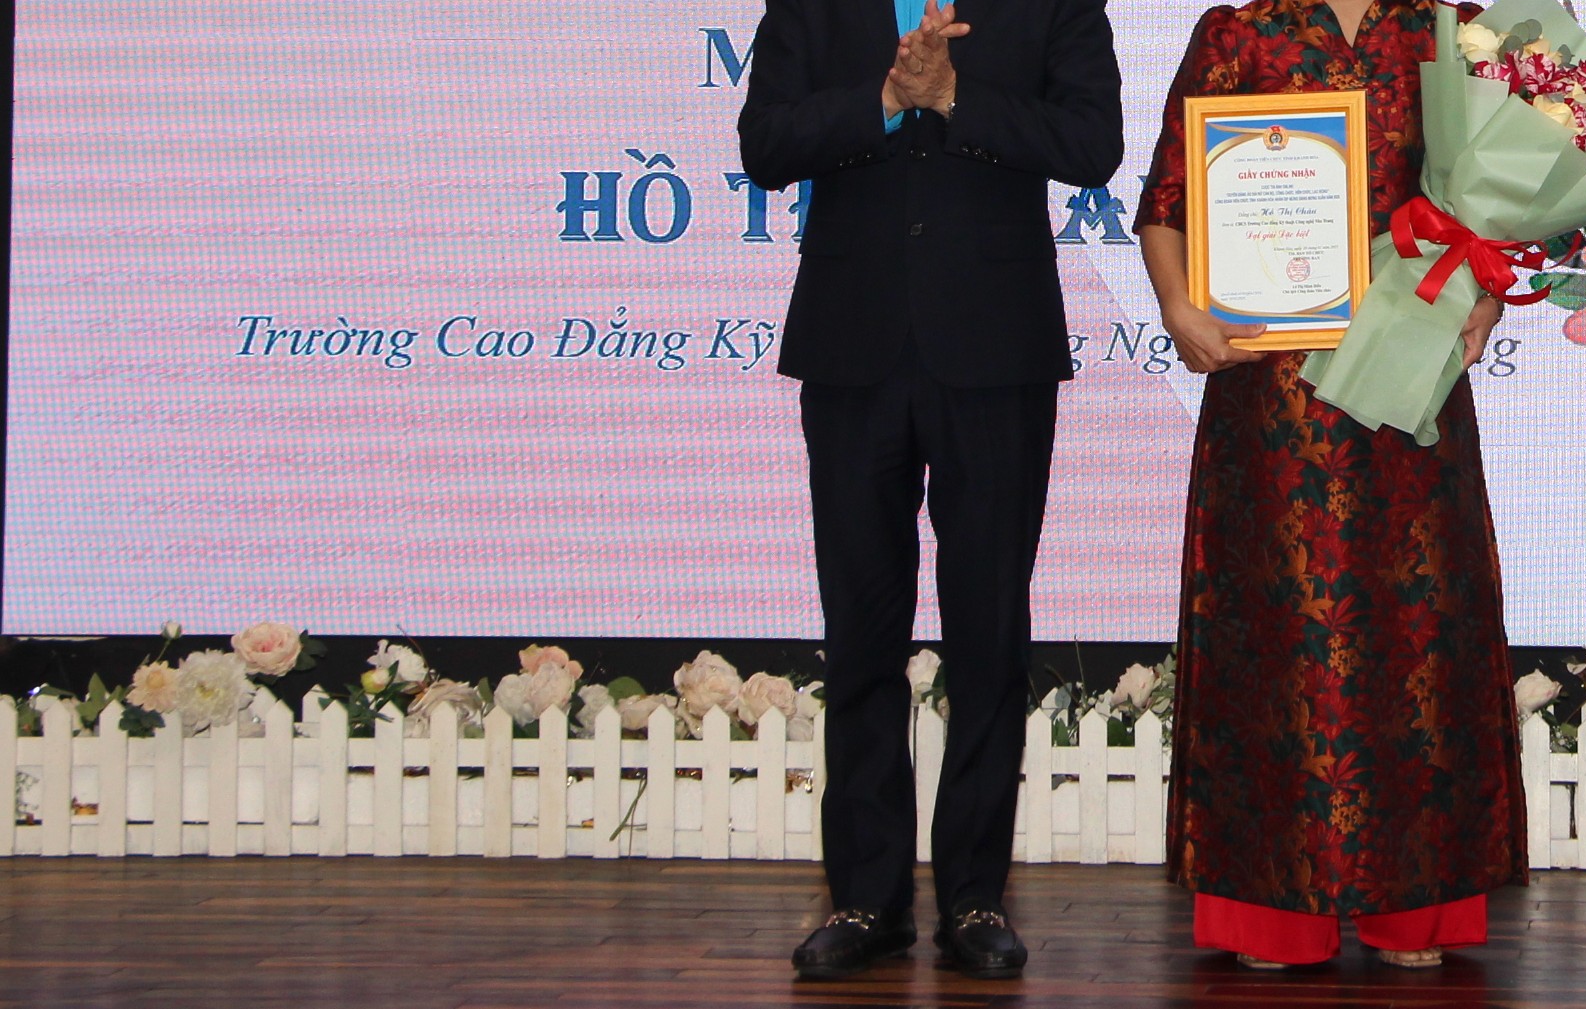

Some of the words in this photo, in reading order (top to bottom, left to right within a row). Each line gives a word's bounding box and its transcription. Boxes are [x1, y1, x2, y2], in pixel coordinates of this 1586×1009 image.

[555, 148, 692, 243] HỒ
[1237, 168, 1258, 180] GIẤY
[1259, 168, 1289, 179] CHỨNG
[1291, 167, 1316, 179] NHẬN
[235, 314, 420, 371] Trường
[436, 314, 535, 359] Cao
[551, 305, 691, 372] Đẳng
[704, 314, 778, 372] Kỹ
